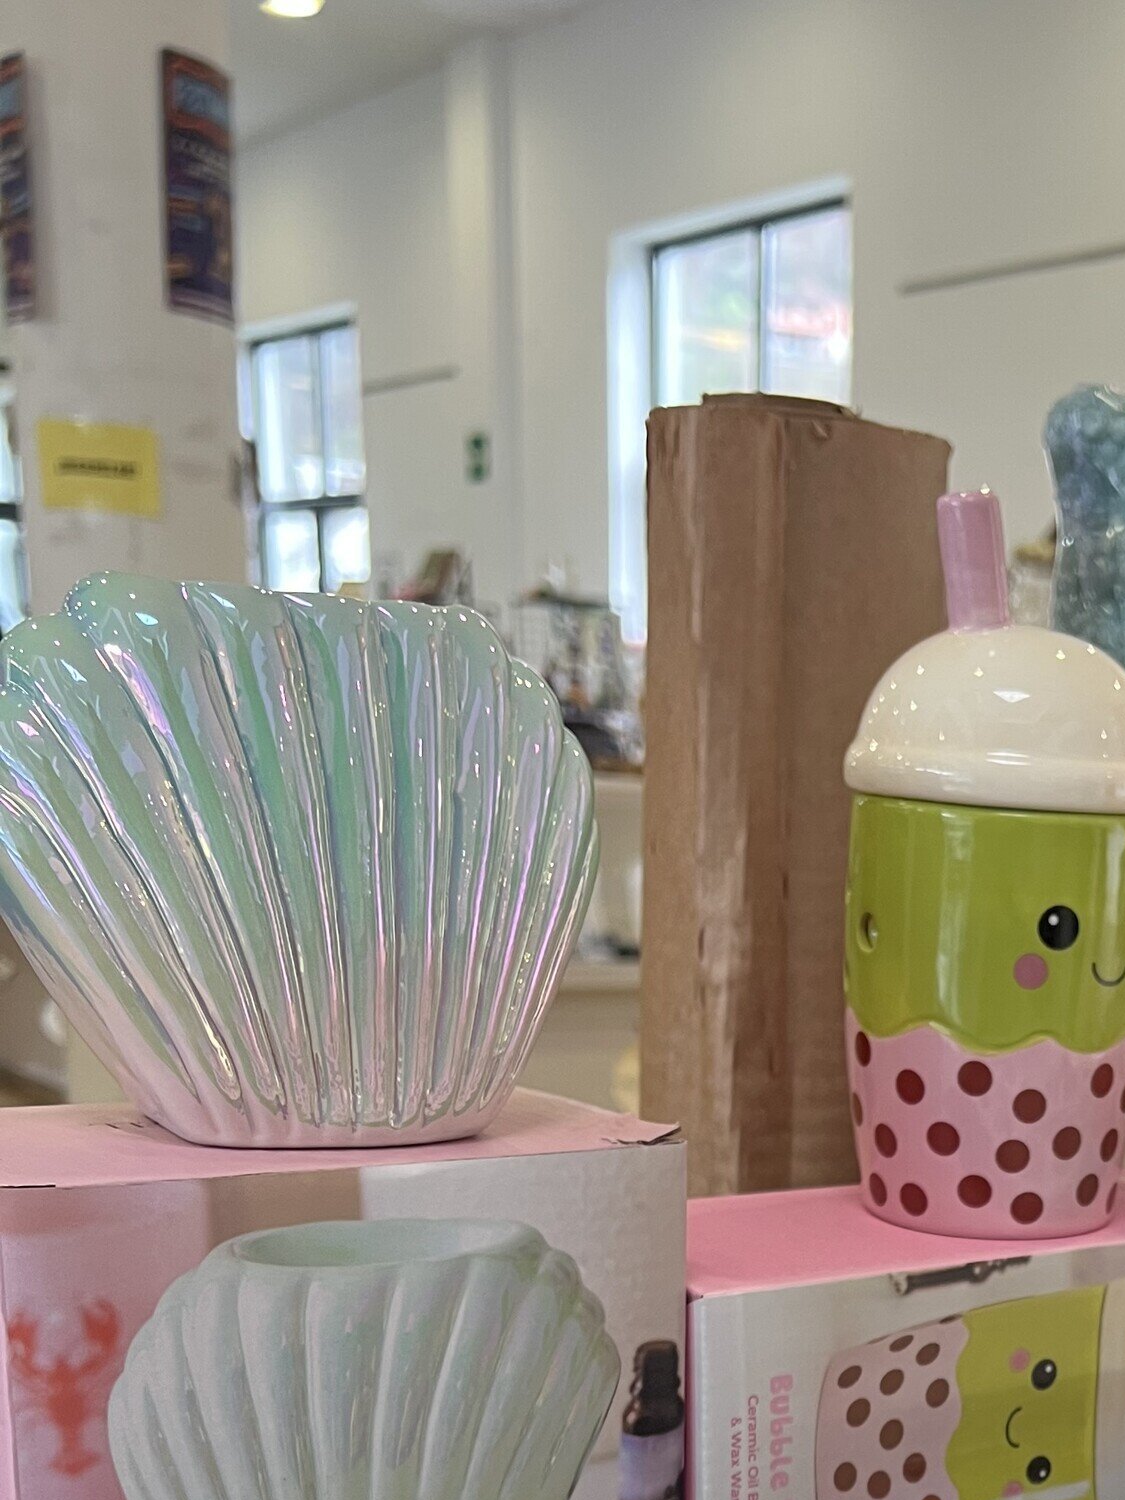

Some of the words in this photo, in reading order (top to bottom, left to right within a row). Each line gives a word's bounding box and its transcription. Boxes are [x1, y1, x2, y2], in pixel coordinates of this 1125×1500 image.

[730, 1417, 742, 1428] &
[747, 1395, 759, 1463] Ceramic
[769, 1375, 794, 1492] Bubble
[730, 1432, 742, 1468] Wax
[748, 1466, 759, 1488] Oil
